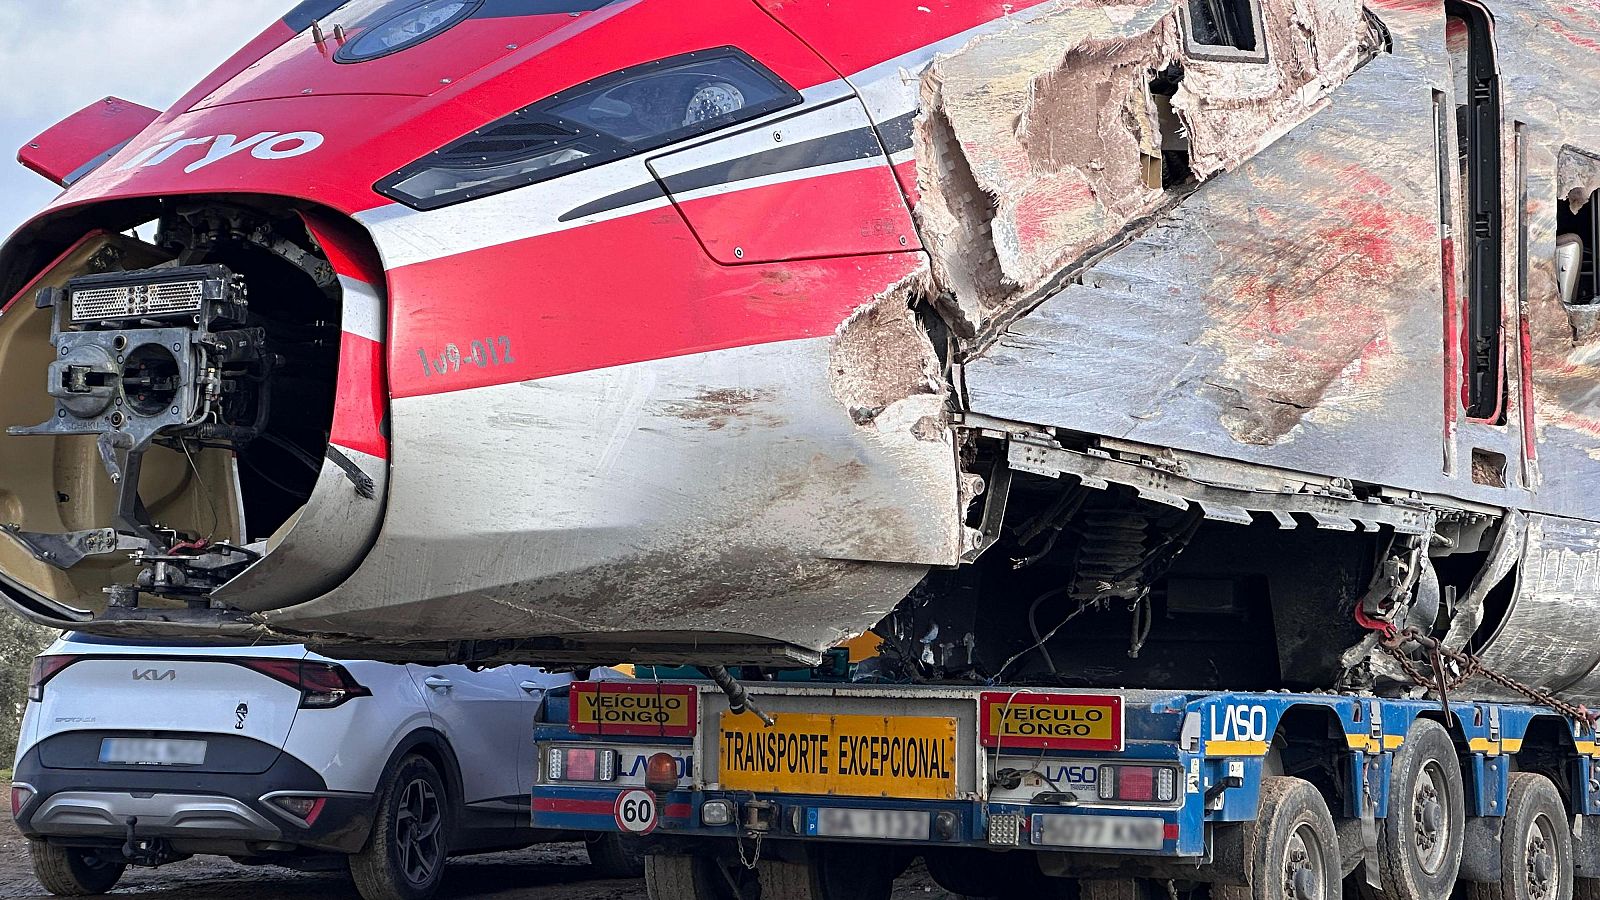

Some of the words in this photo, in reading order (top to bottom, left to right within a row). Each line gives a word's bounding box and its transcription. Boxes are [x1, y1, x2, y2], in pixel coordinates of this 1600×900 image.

[112, 130, 325, 174] iryo
[131, 668, 176, 681] KIA
[586, 694, 681, 709] VEÍCULO
[592, 710, 670, 723] LONGO
[997, 706, 1103, 721] VEÍCULO
[1004, 722, 1091, 736] LONGO
[1211, 704, 1267, 741] LASO
[725, 731, 829, 775] TRANSPORTE
[838, 735, 950, 779] EXCEPCIONAL
[1046, 766, 1097, 783] LASO
[623, 799, 651, 823] 60
